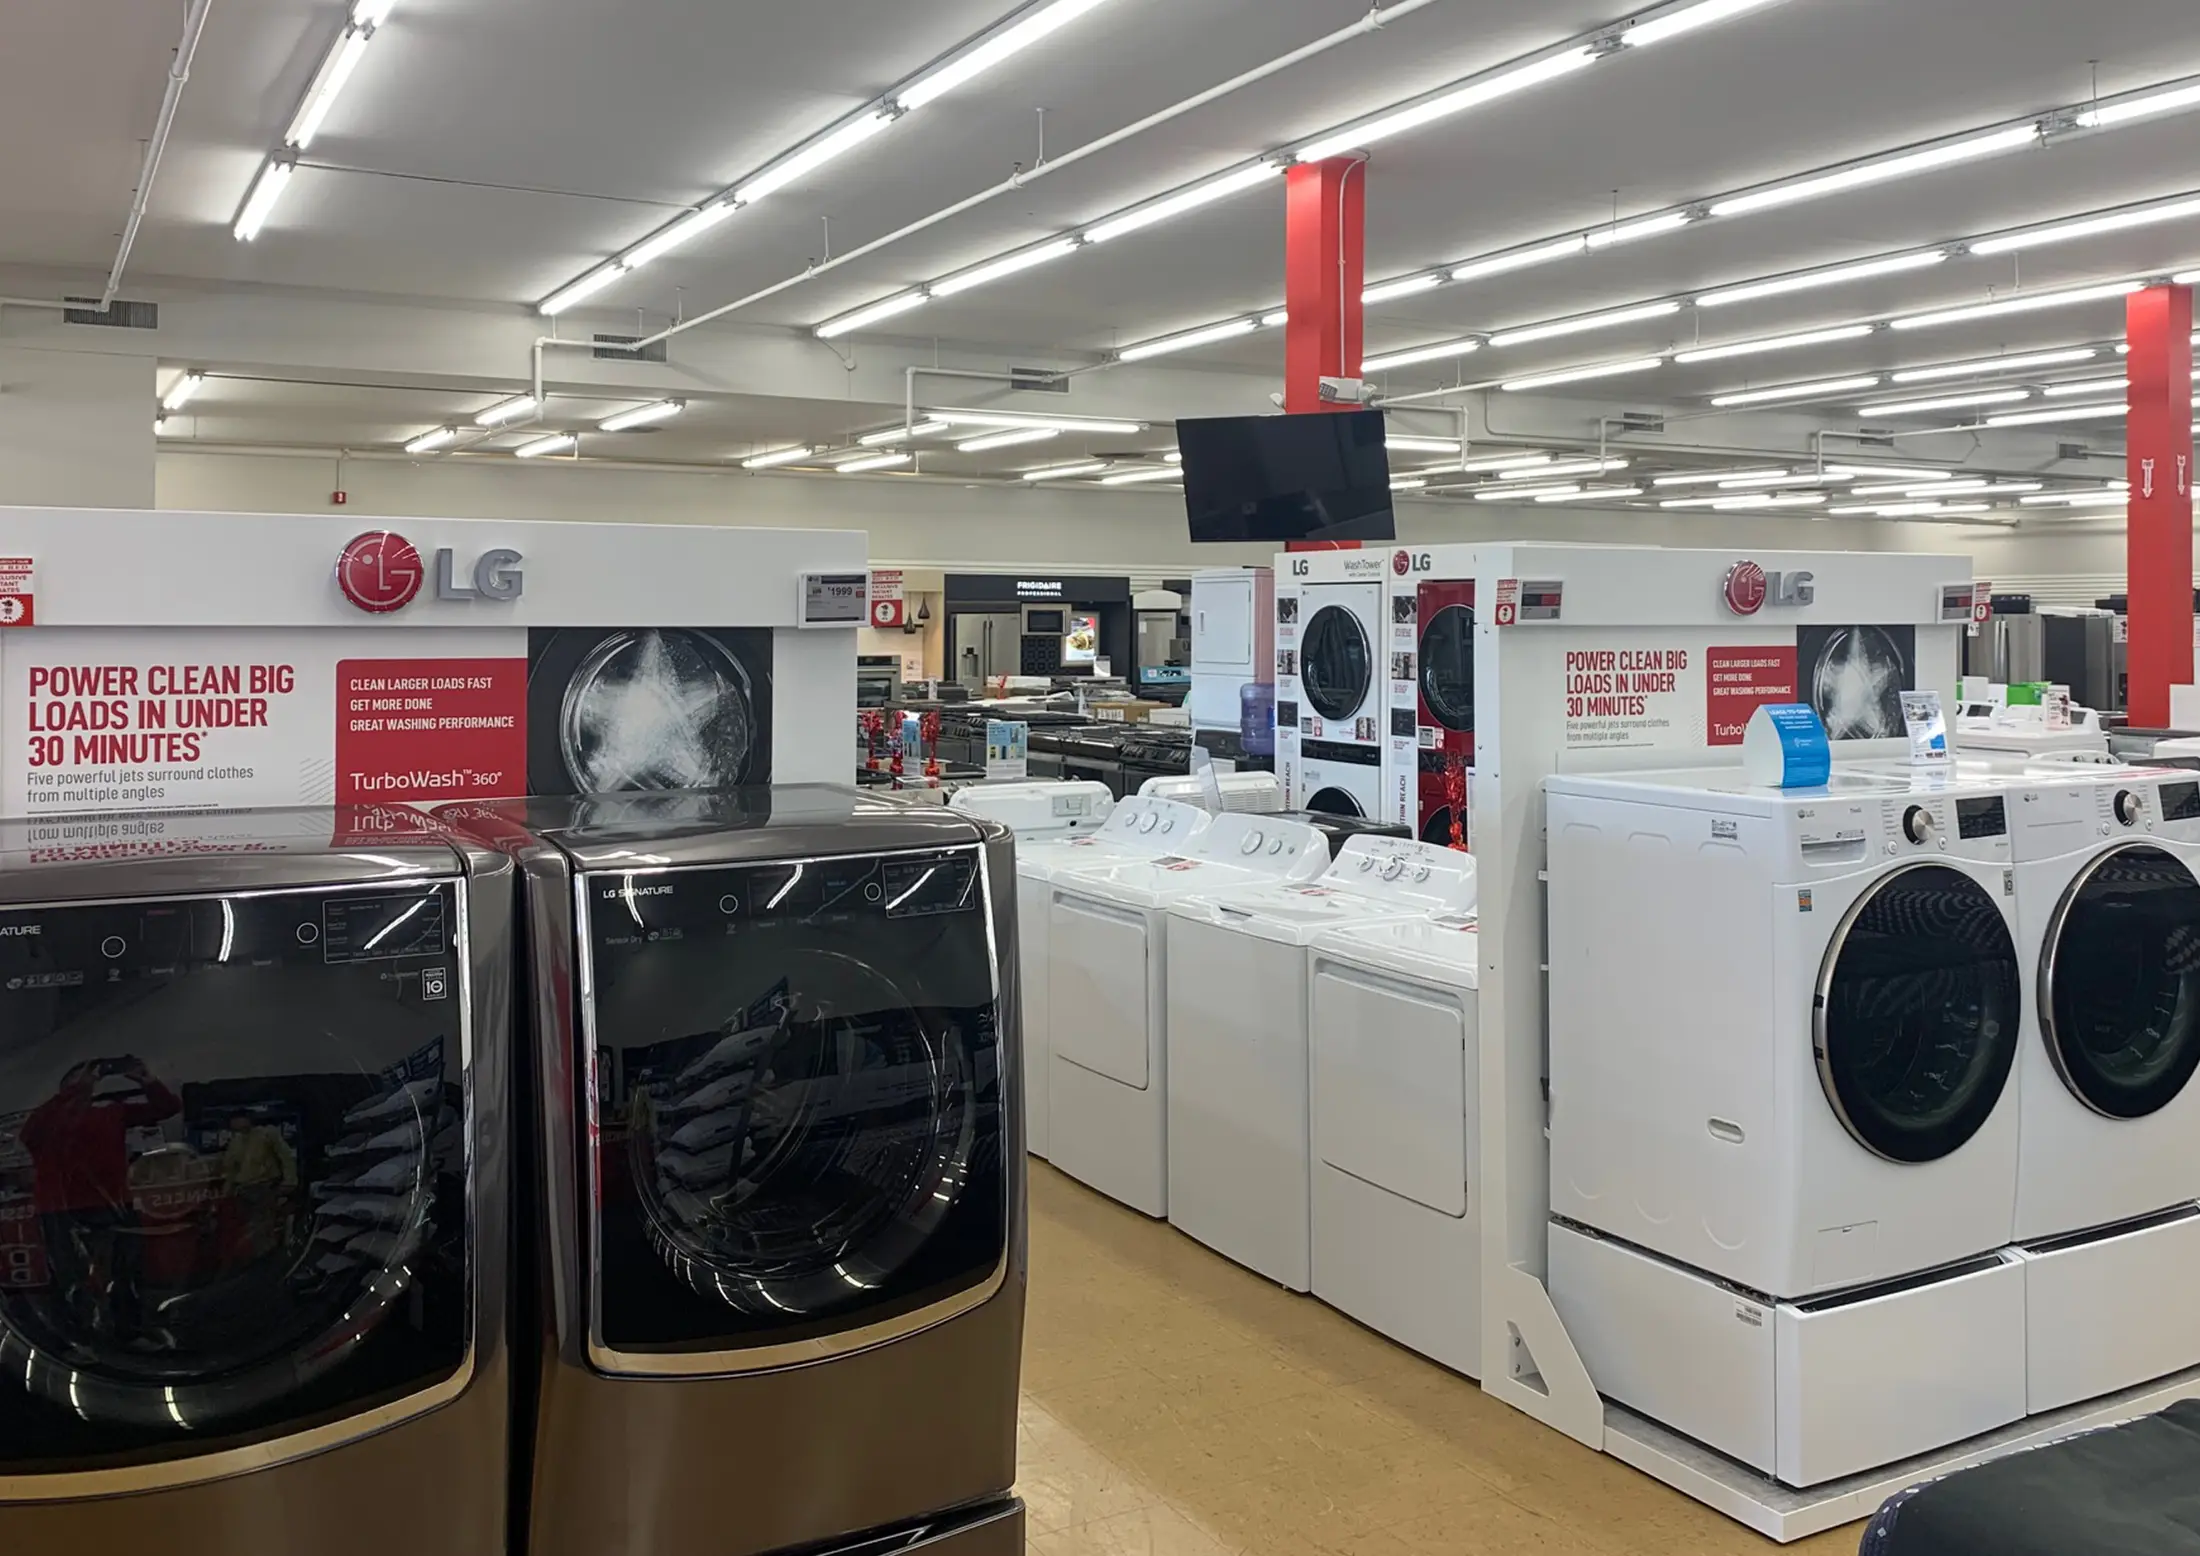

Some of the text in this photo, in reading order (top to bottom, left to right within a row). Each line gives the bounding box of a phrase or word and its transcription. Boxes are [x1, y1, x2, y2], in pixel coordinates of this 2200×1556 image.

[1293, 560, 1309, 576] LG
[1412, 554, 1431, 572] LG
[437, 548, 524, 601] LG
[1017, 581, 1062, 590] FRIGIDAIRE
[1766, 571, 1815, 606] LG
[1567, 650, 1687, 672] POWER CLEAN BIG
[1712, 658, 1780, 668] CLEAN LARGER LOADS FAST
[29, 665, 294, 698] POWER CLEAN BIG
[350, 677, 492, 691] CLEAN LARGER LOADS FAST
[1567, 673, 1675, 694] LOADS IN UNDER
[1713, 673, 1752, 682] GET MORE DONE
[1713, 686, 1791, 696] GREAT WASHING PERFORMANCE
[350, 698, 433, 711] GET MORE DONE
[1567, 697, 1583, 717] 30
[29, 698, 268, 732] LOADS IN UNDER
[350, 716, 514, 731] GREAT WASHING PERFORMANCE
[1566, 721, 1579, 730] Five
[1580, 720, 1606, 731] powerful
[1620, 719, 1647, 729] surround
[1647, 718, 1670, 728] clothes
[1566, 731, 1629, 742] from multiple angles
[28, 735, 64, 767] 30
[27, 766, 254, 787] Five powerful jets surround clothes
[27, 785, 165, 803] from multiple angles
[603, 886, 673, 899] LG SNATURE
